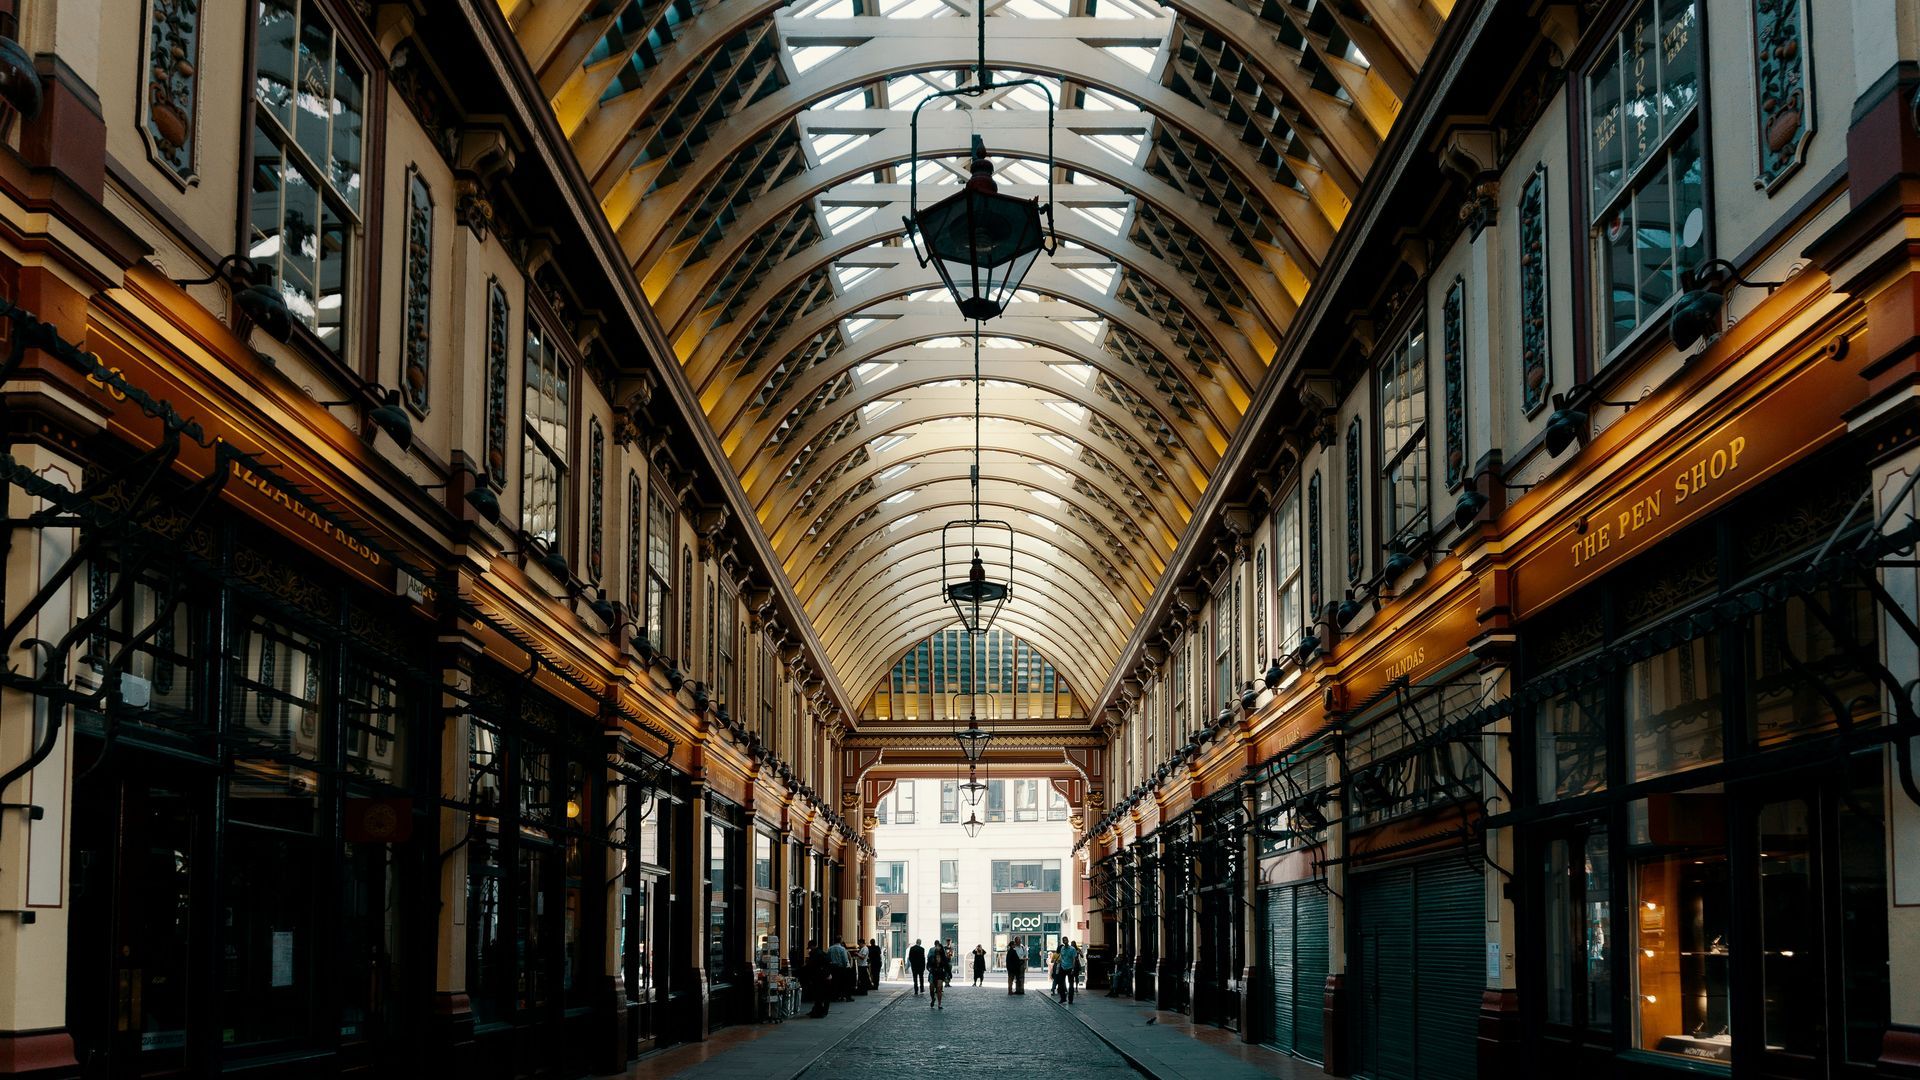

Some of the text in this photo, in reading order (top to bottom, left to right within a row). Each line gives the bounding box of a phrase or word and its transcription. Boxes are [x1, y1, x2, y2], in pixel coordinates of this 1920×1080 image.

[1667, 31, 1689, 65] BAR
[1634, 18, 1647, 156] BROKRS
[1594, 103, 1620, 138] WINE
[1598, 124, 1617, 152] BAR
[1571, 436, 1746, 567] THE PEN SHOP
[1385, 646, 1425, 682] VIANDAS
[1012, 914, 1041, 931] pod
